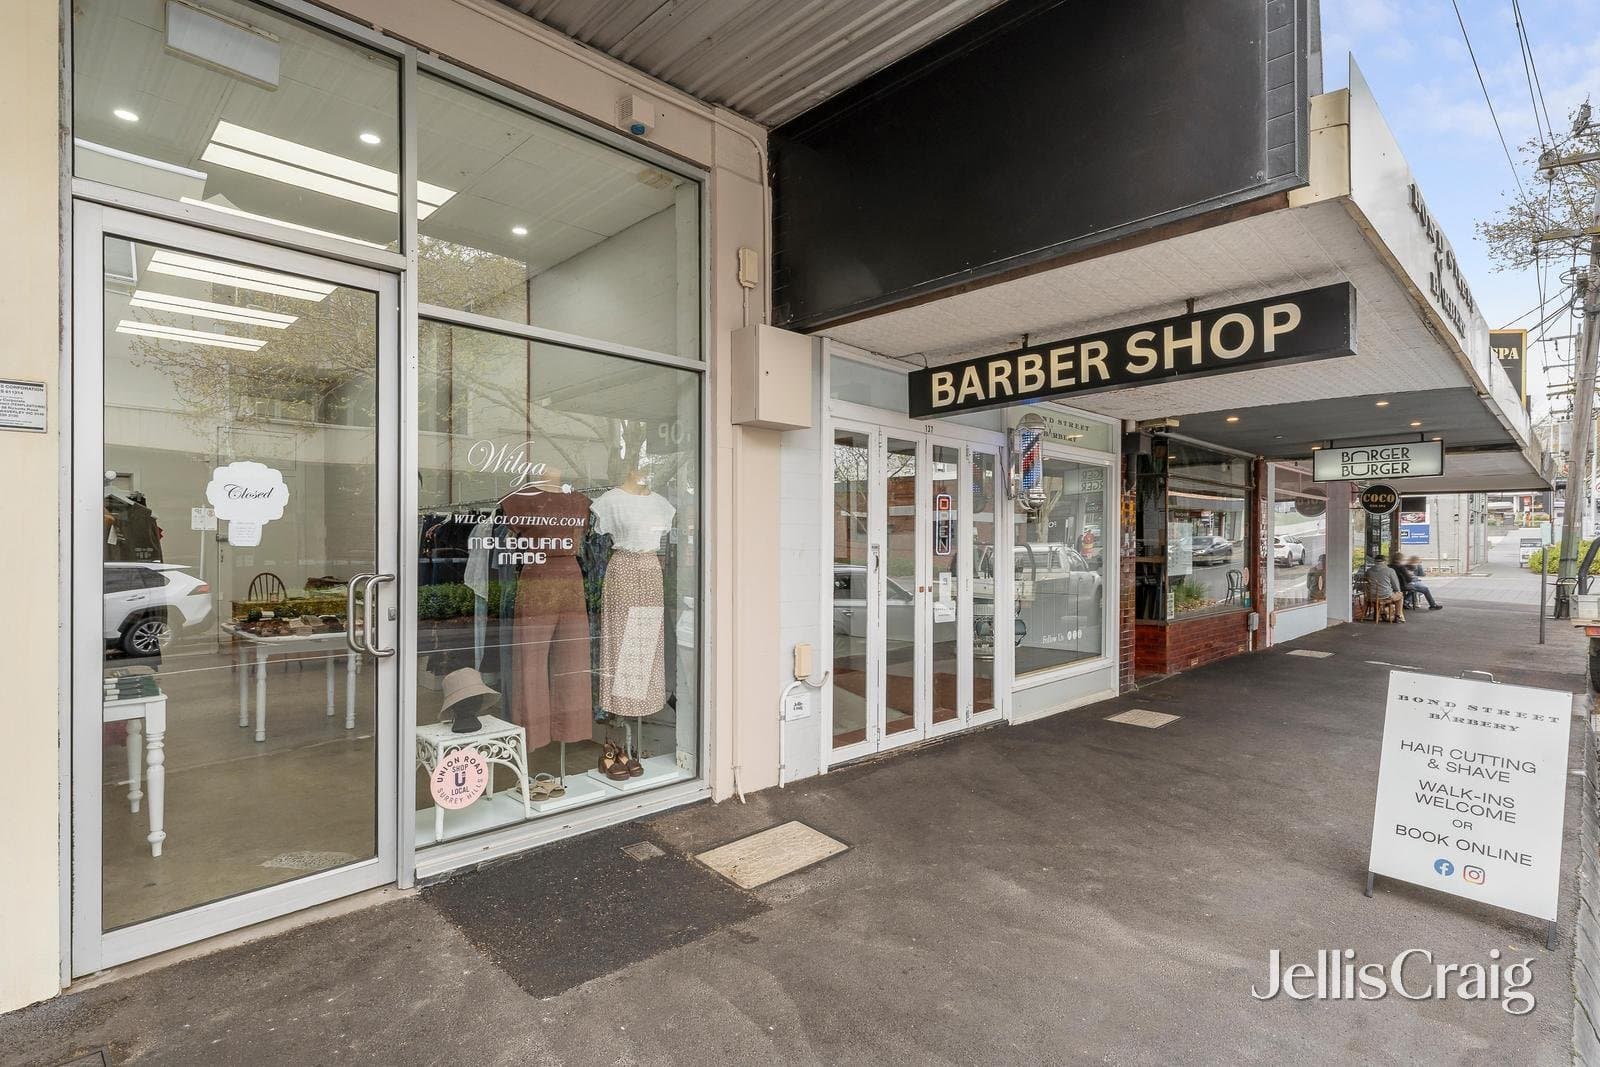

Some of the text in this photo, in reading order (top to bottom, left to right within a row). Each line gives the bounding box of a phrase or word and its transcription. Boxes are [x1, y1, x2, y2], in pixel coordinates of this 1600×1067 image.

[931, 303, 1302, 408] BARBER SHOP
[925, 424, 934, 433] 137
[1057, 419, 1090, 431] STREET
[467, 439, 547, 488] Wilga
[1341, 461, 1410, 477] BURGER
[223, 483, 275, 500] Closed
[1362, 493, 1396, 503] COCO
[454, 513, 586, 527] WILGACLOTHING.COM
[467, 536, 573, 550] MELBOURNE
[498, 551, 547, 565] MADE
[1398, 694, 1561, 724] BOND STREET
[1428, 709, 1521, 732] BARBERY
[1400, 739, 1537, 774] HAIR CUTTING
[437, 755, 483, 783] UNION ROAD
[452, 763, 469, 773] SHOP
[1427, 758, 1511, 783] & SHAVE
[437, 787, 464, 804] SURREY
[451, 786, 470, 796] LOCAL
[1418, 779, 1515, 809] WALK-INS
[1415, 792, 1517, 824] WELCOME
[1452, 818, 1473, 831] OR
[1395, 824, 1533, 867] BOOK ONLINE
